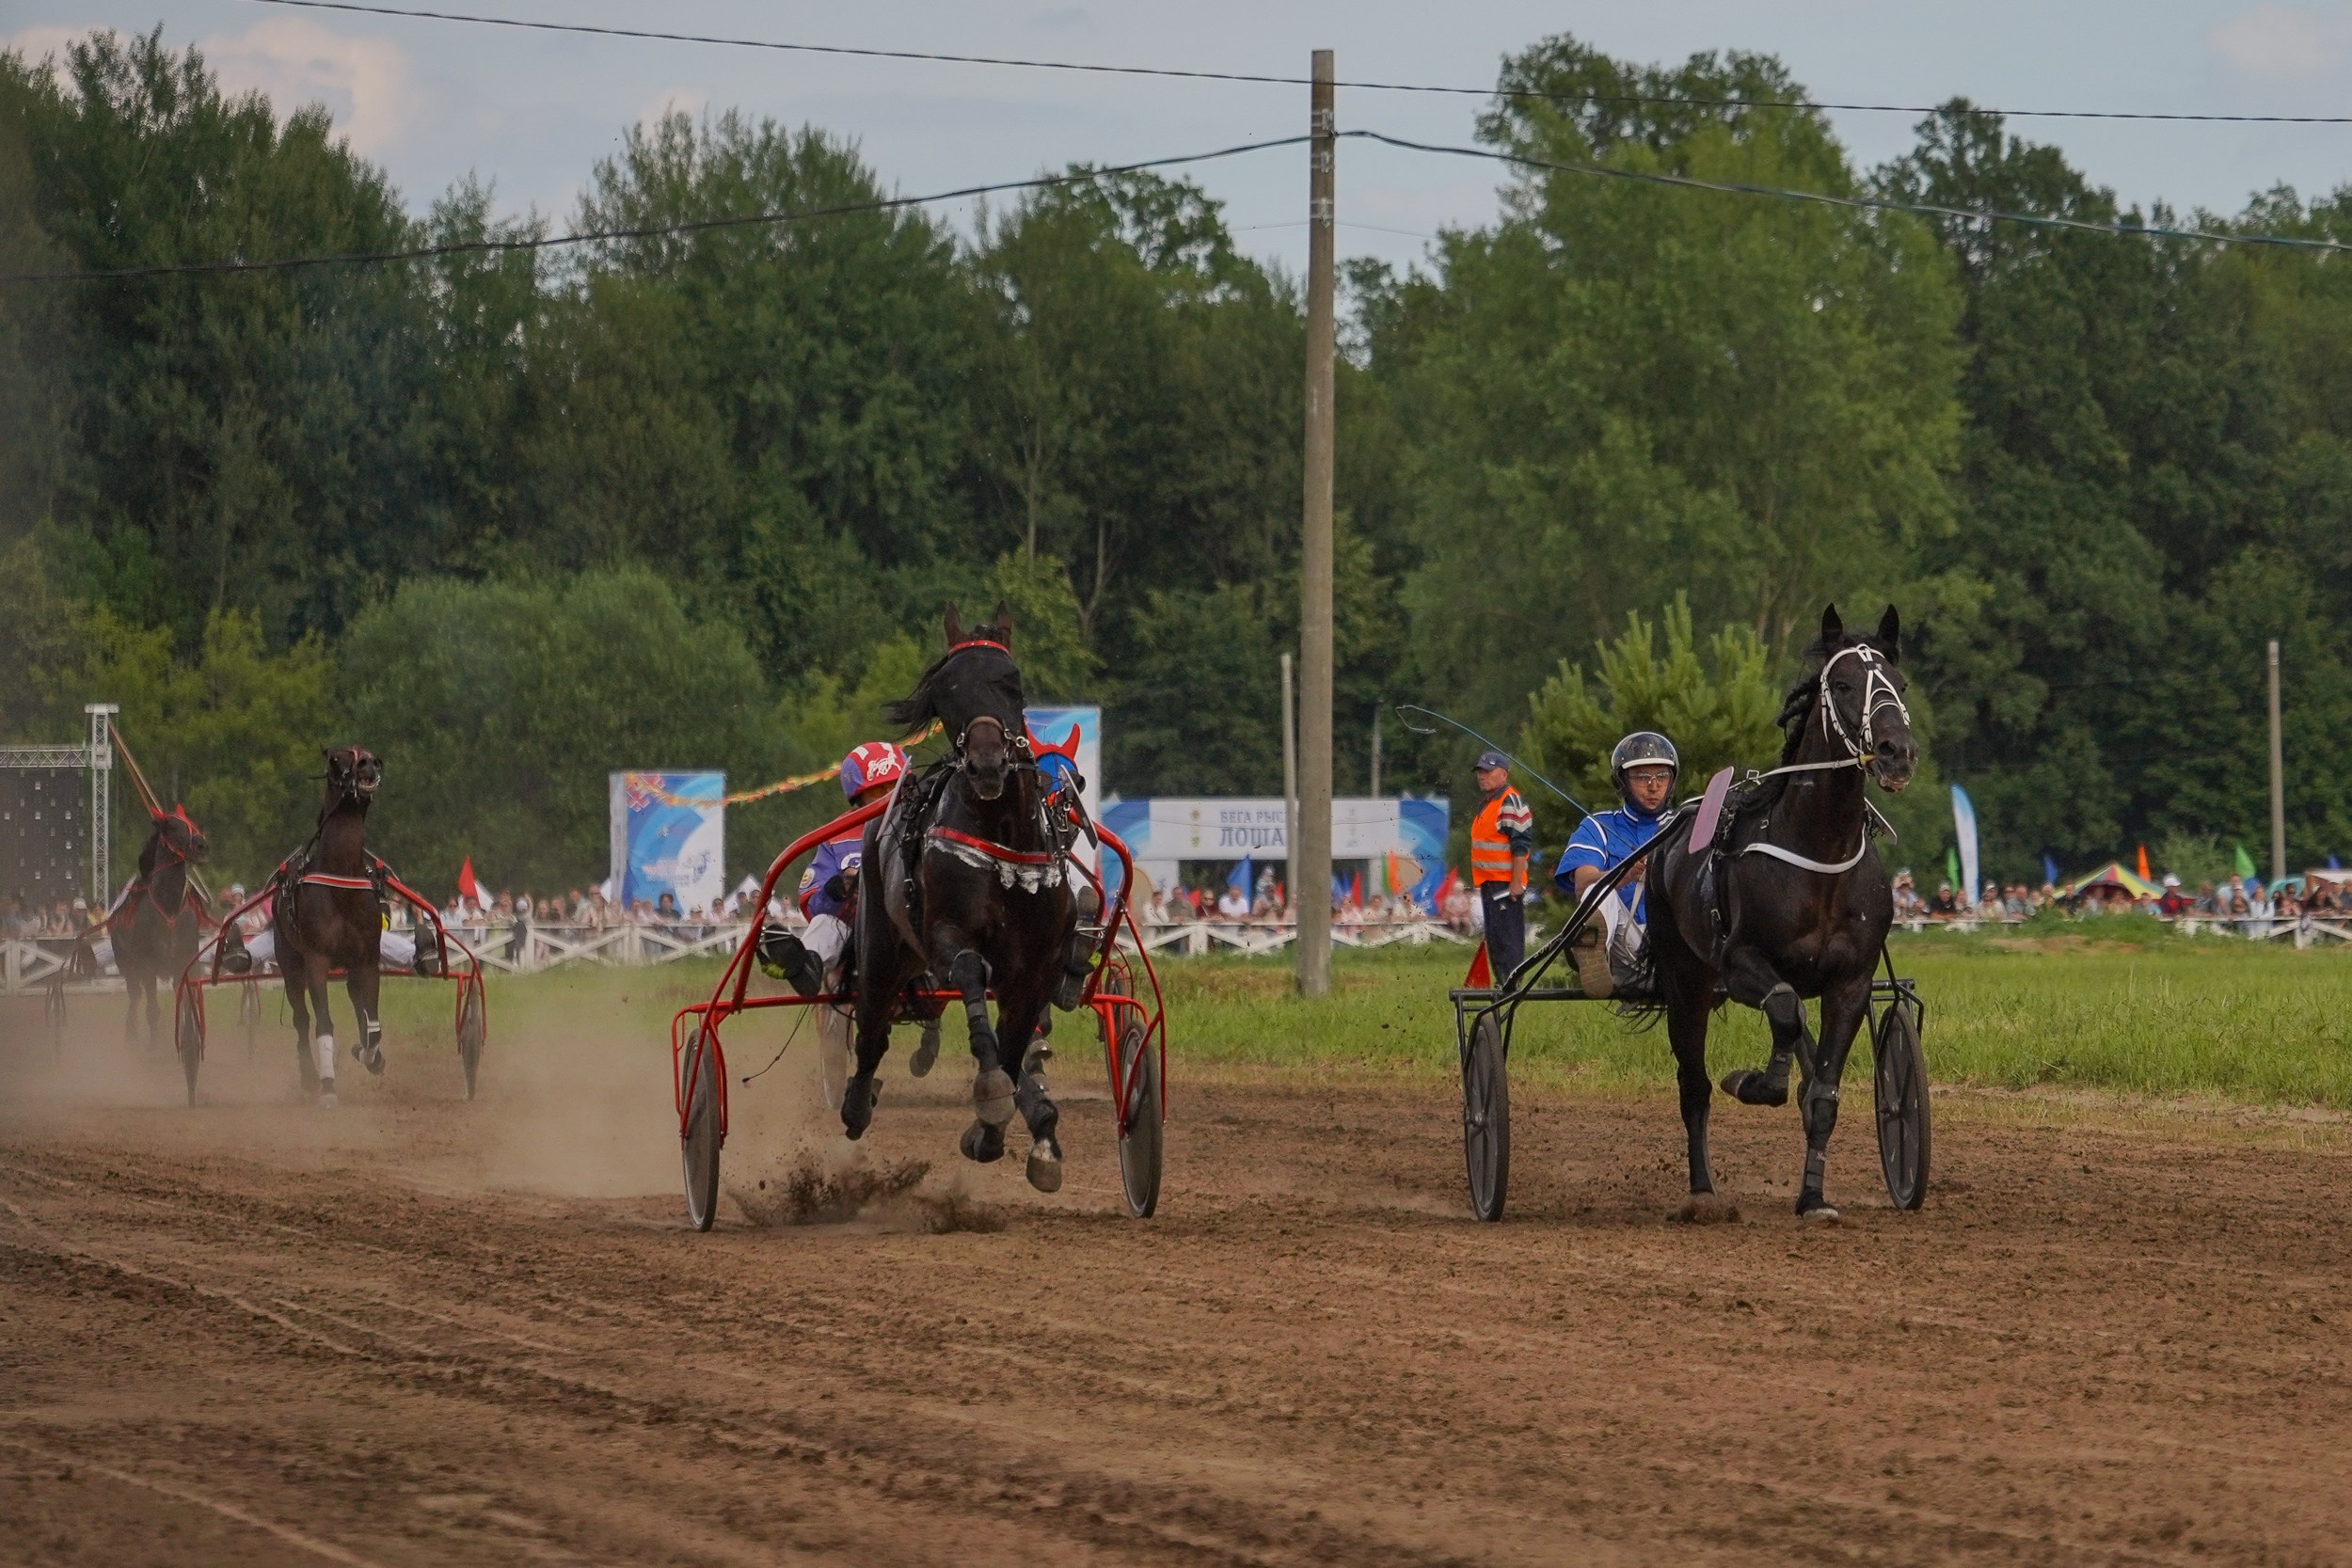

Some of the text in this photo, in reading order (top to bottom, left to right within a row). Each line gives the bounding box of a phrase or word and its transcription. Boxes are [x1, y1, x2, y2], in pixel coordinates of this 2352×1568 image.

[1219, 812, 1285, 824] БЕГА РЫС
[1219, 828, 1285, 847] ЛОША
